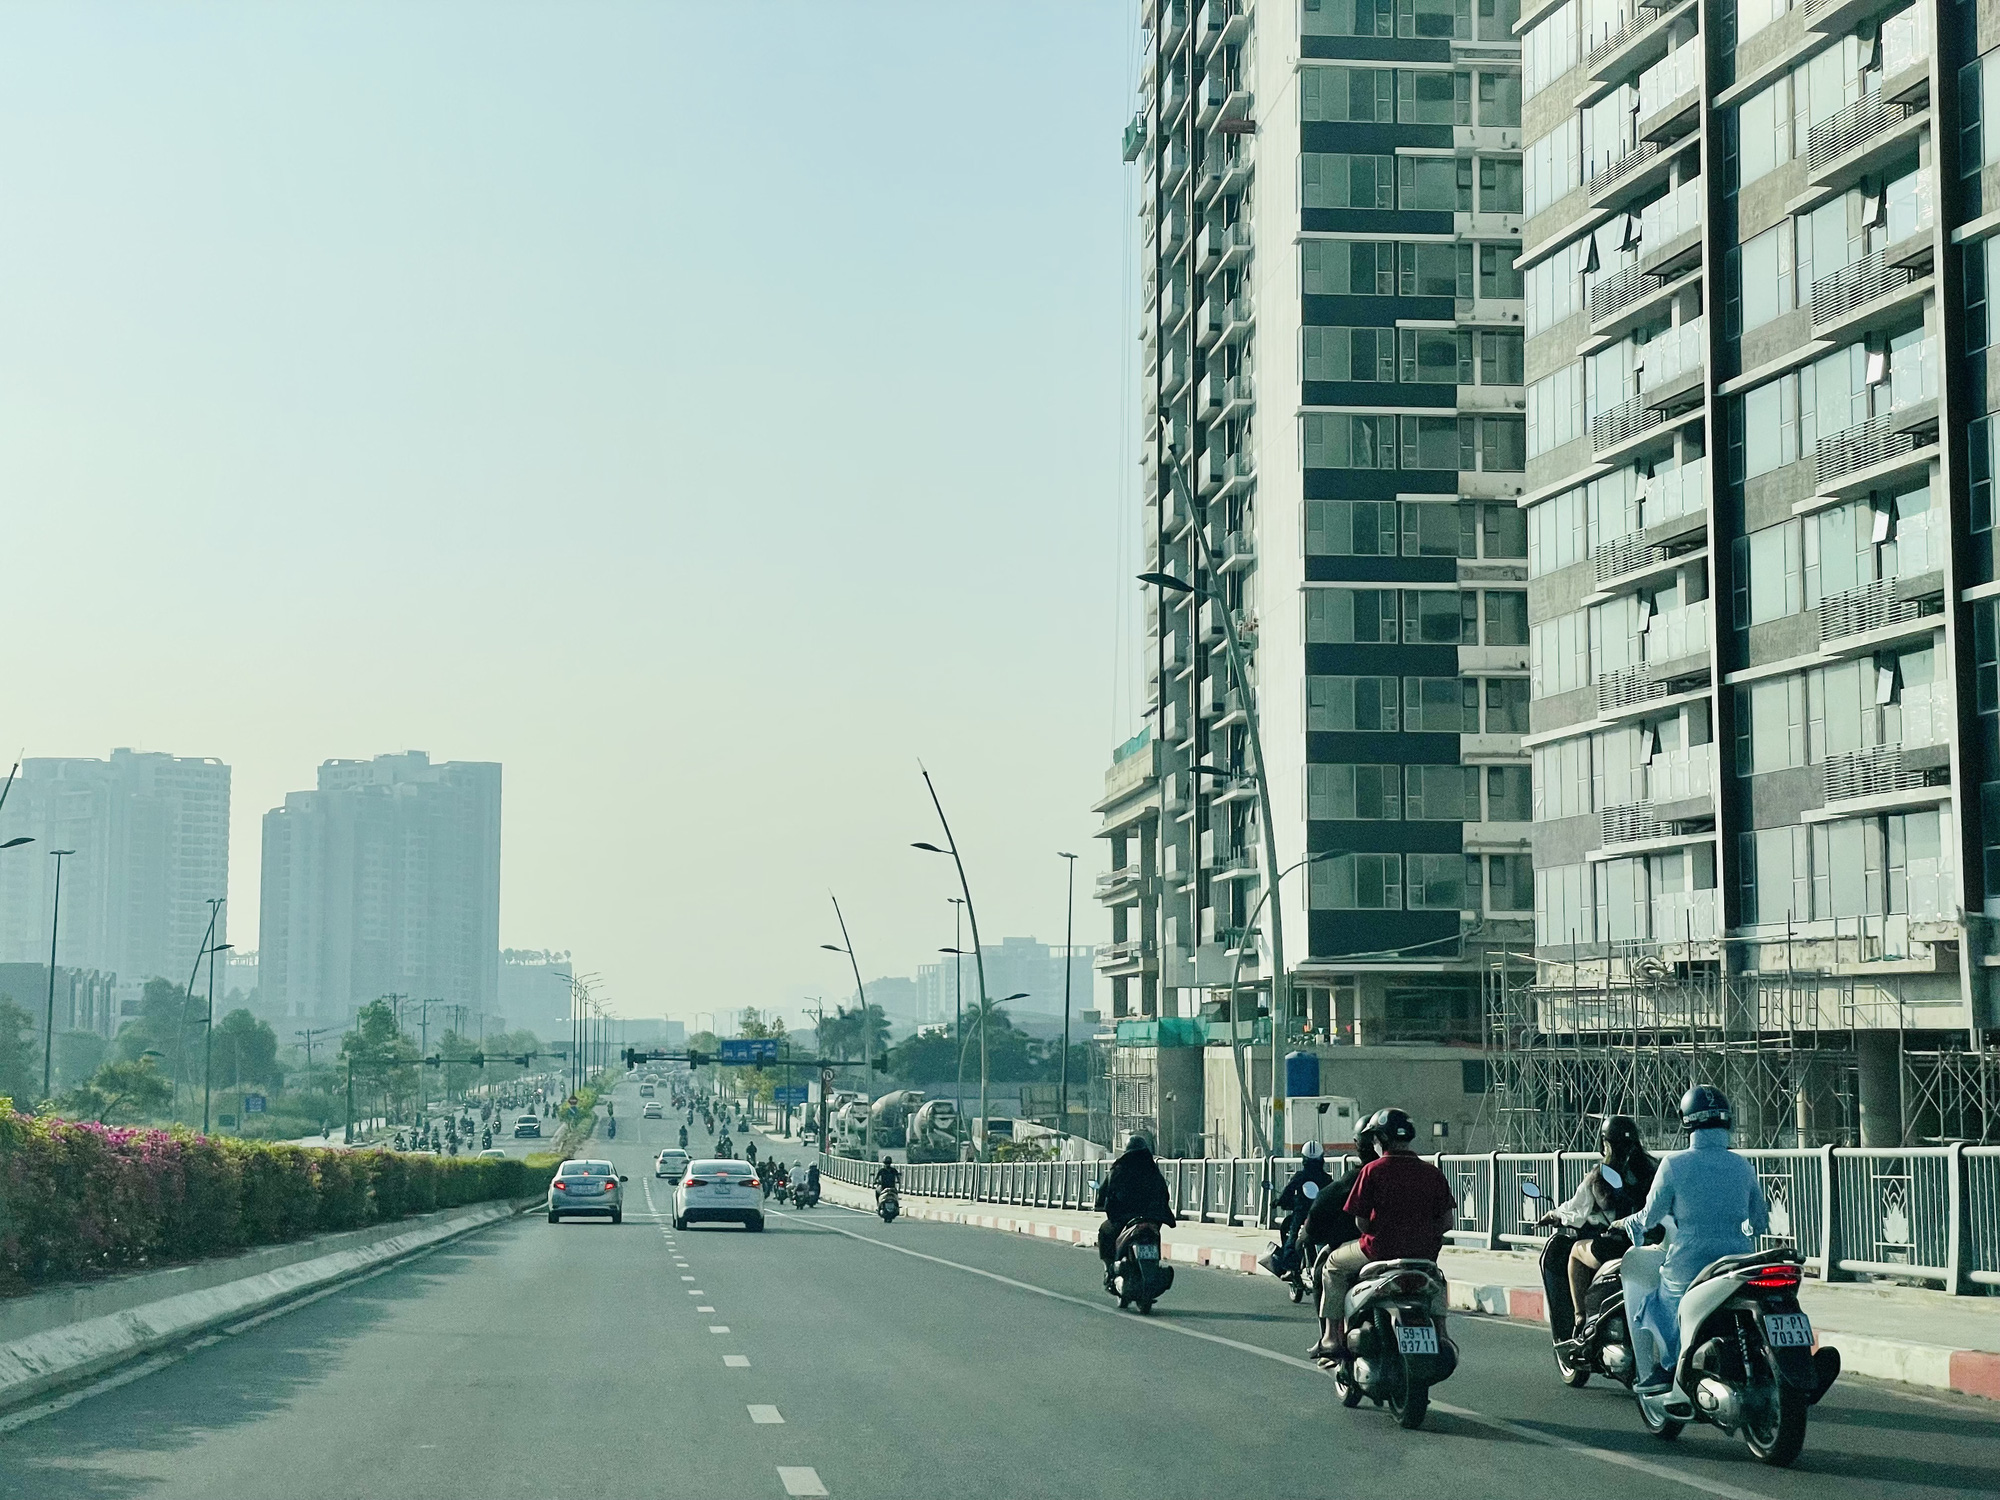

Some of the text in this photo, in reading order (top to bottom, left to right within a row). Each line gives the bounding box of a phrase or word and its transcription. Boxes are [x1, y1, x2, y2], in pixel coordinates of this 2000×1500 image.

[1772, 1316, 1804, 1330] 37-P1
[1403, 1328, 1431, 1340] 59-T1
[1772, 1330, 1811, 1345] 703.31
